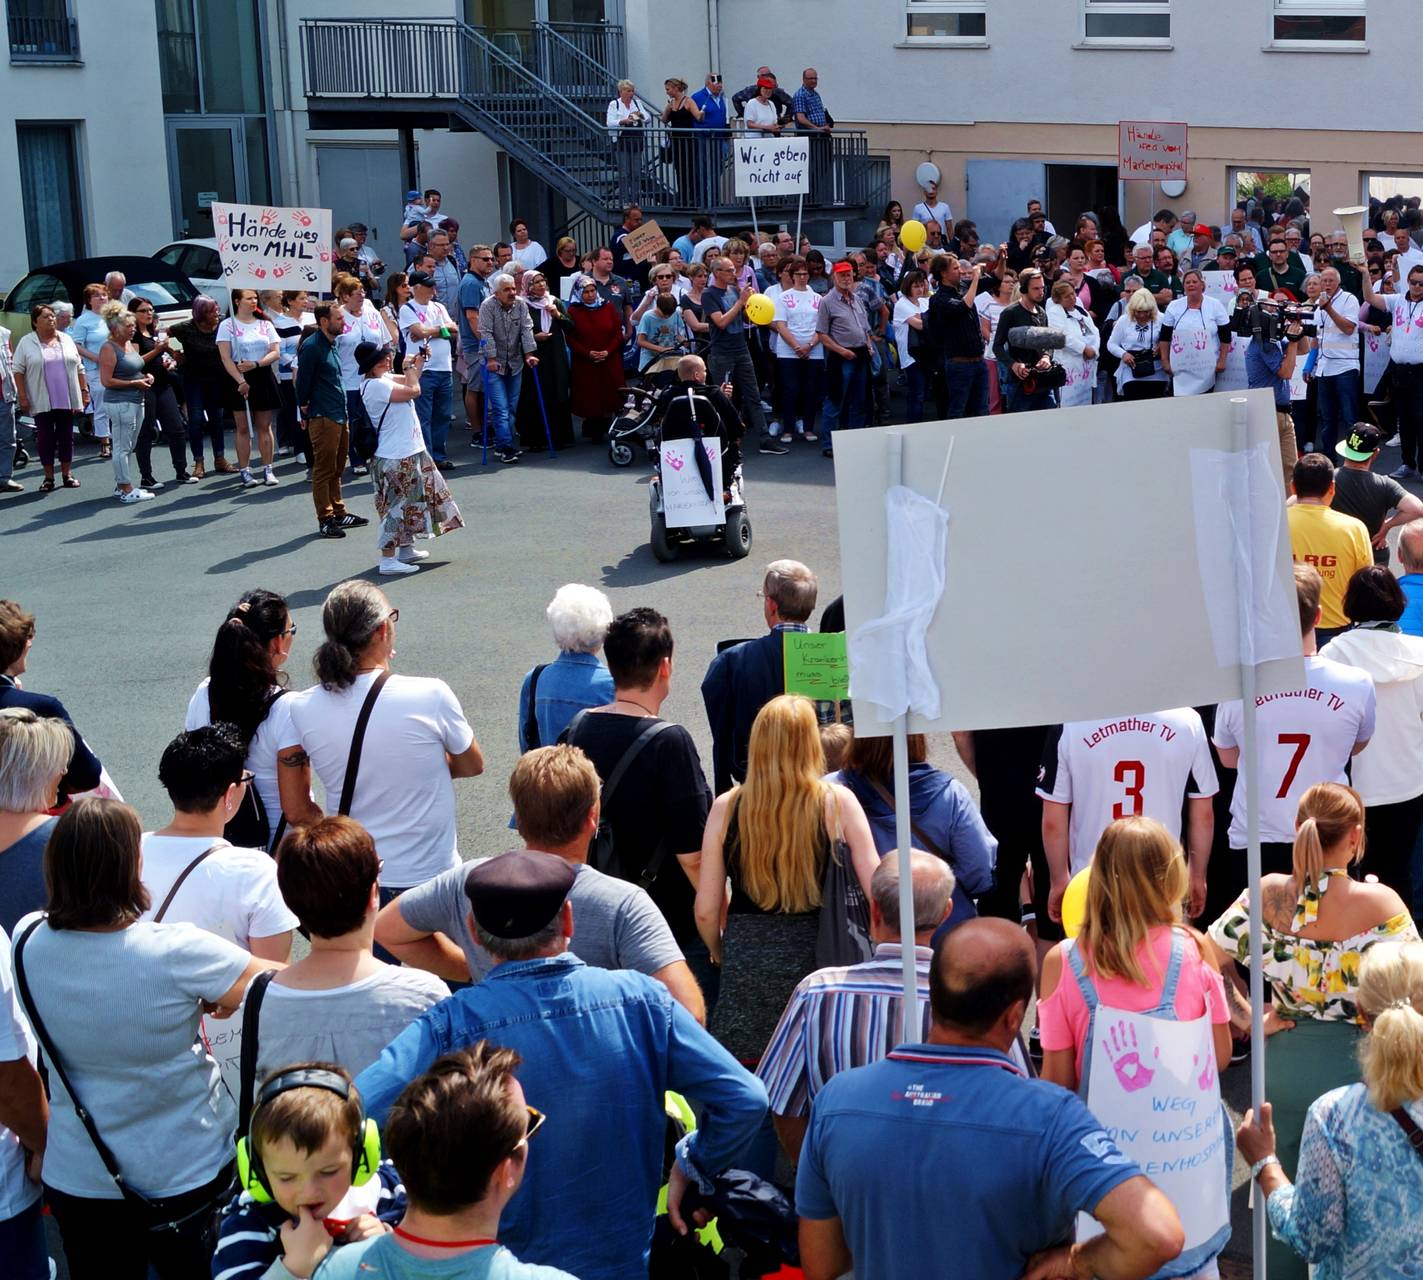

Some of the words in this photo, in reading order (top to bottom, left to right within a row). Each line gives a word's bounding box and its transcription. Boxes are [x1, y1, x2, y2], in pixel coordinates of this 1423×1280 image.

[740, 145, 764, 164] Wir
[773, 144, 807, 166] geben
[750, 168, 780, 183] nicht
[784, 170, 802, 184] auf
[228, 211, 287, 239] Hände
[294, 230, 319, 243] weg
[231, 243, 259, 252] vom
[263, 240, 313, 259] MHL
[1327, 693, 1345, 712] TV
[1083, 716, 1157, 749] Letmather
[1159, 724, 1177, 742] TV
[1276, 733, 1312, 799] 7
[1112, 760, 1145, 821] 3
[1152, 1095, 1197, 1117] WEG
[1104, 1126, 1140, 1143] ON
